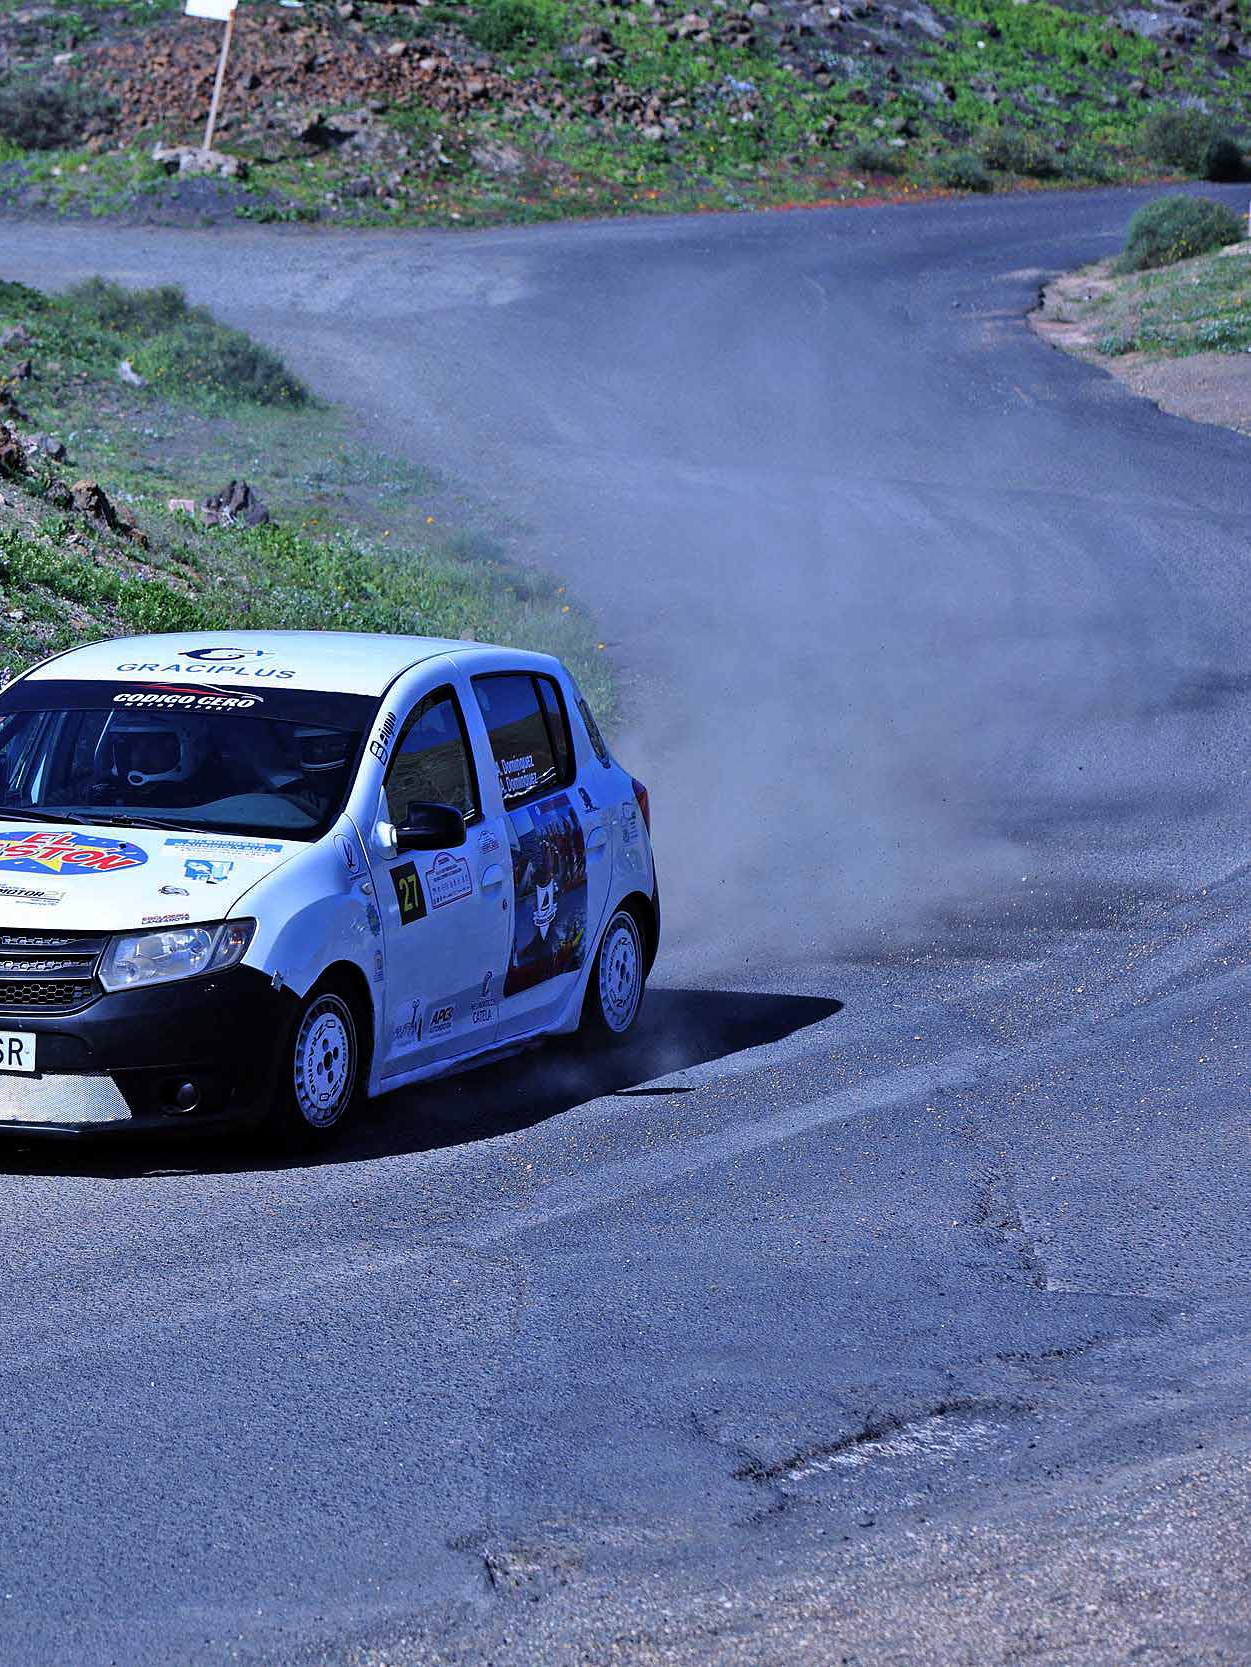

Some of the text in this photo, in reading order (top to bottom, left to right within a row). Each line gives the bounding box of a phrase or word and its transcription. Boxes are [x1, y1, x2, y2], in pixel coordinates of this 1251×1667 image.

[116, 663, 296, 679] GRACIPLUS
[113, 693, 255, 708] CODIGO CERO
[22, 832, 78, 846] EL
[399, 874, 419, 912] 27
